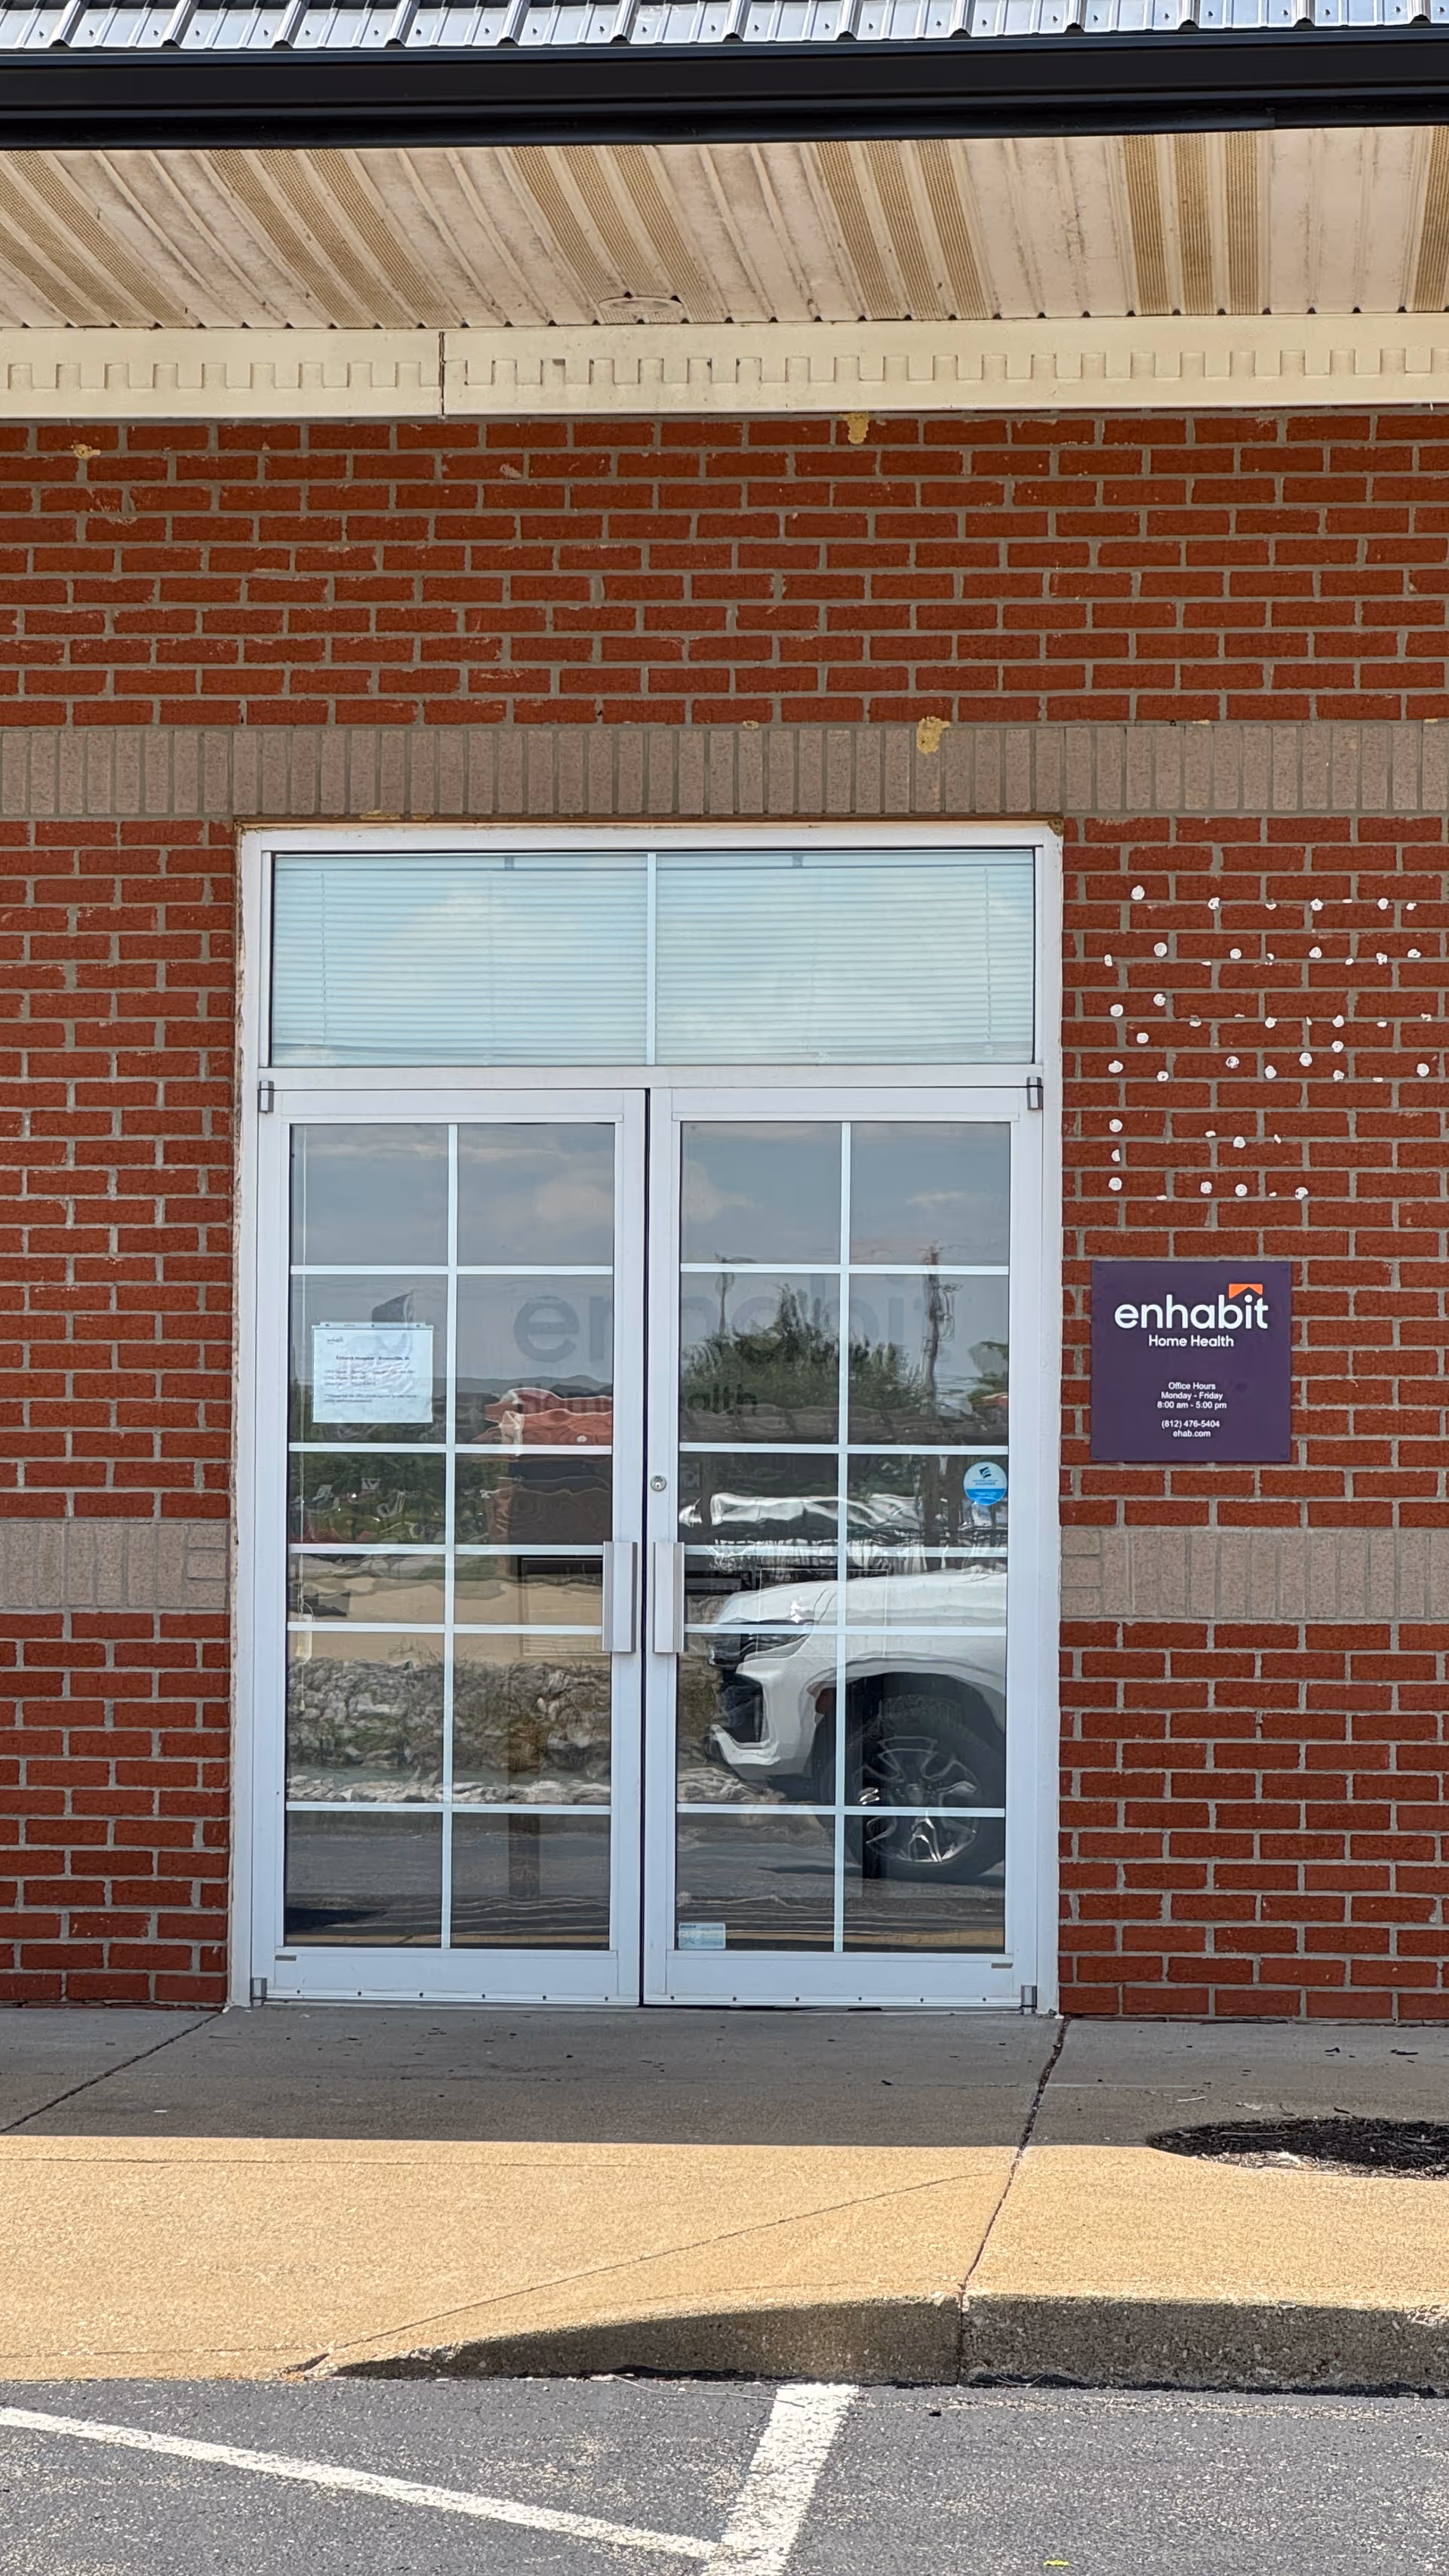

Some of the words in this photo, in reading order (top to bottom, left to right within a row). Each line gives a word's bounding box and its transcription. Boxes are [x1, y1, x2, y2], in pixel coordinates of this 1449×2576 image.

[1114, 1294, 1269, 1329] enhabit
[1149, 1334, 1188, 1347] Home
[1190, 1334, 1234, 1347] Health
[1168, 1382, 1191, 1390] Office
[1192, 1382, 1216, 1390] Hours
[1161, 1391, 1192, 1401] Monday
[1198, 1391, 1223, 1401] Friday
[1157, 1401, 1174, 1409] 8:00
[1195, 1401, 1213, 1409] 5:00
[1214, 1402, 1227, 1411] pm
[1161, 1420, 1182, 1430] (812)
[1183, 1420, 1220, 1428] 476-5404
[1173, 1430, 1211, 1438] ehab.com
